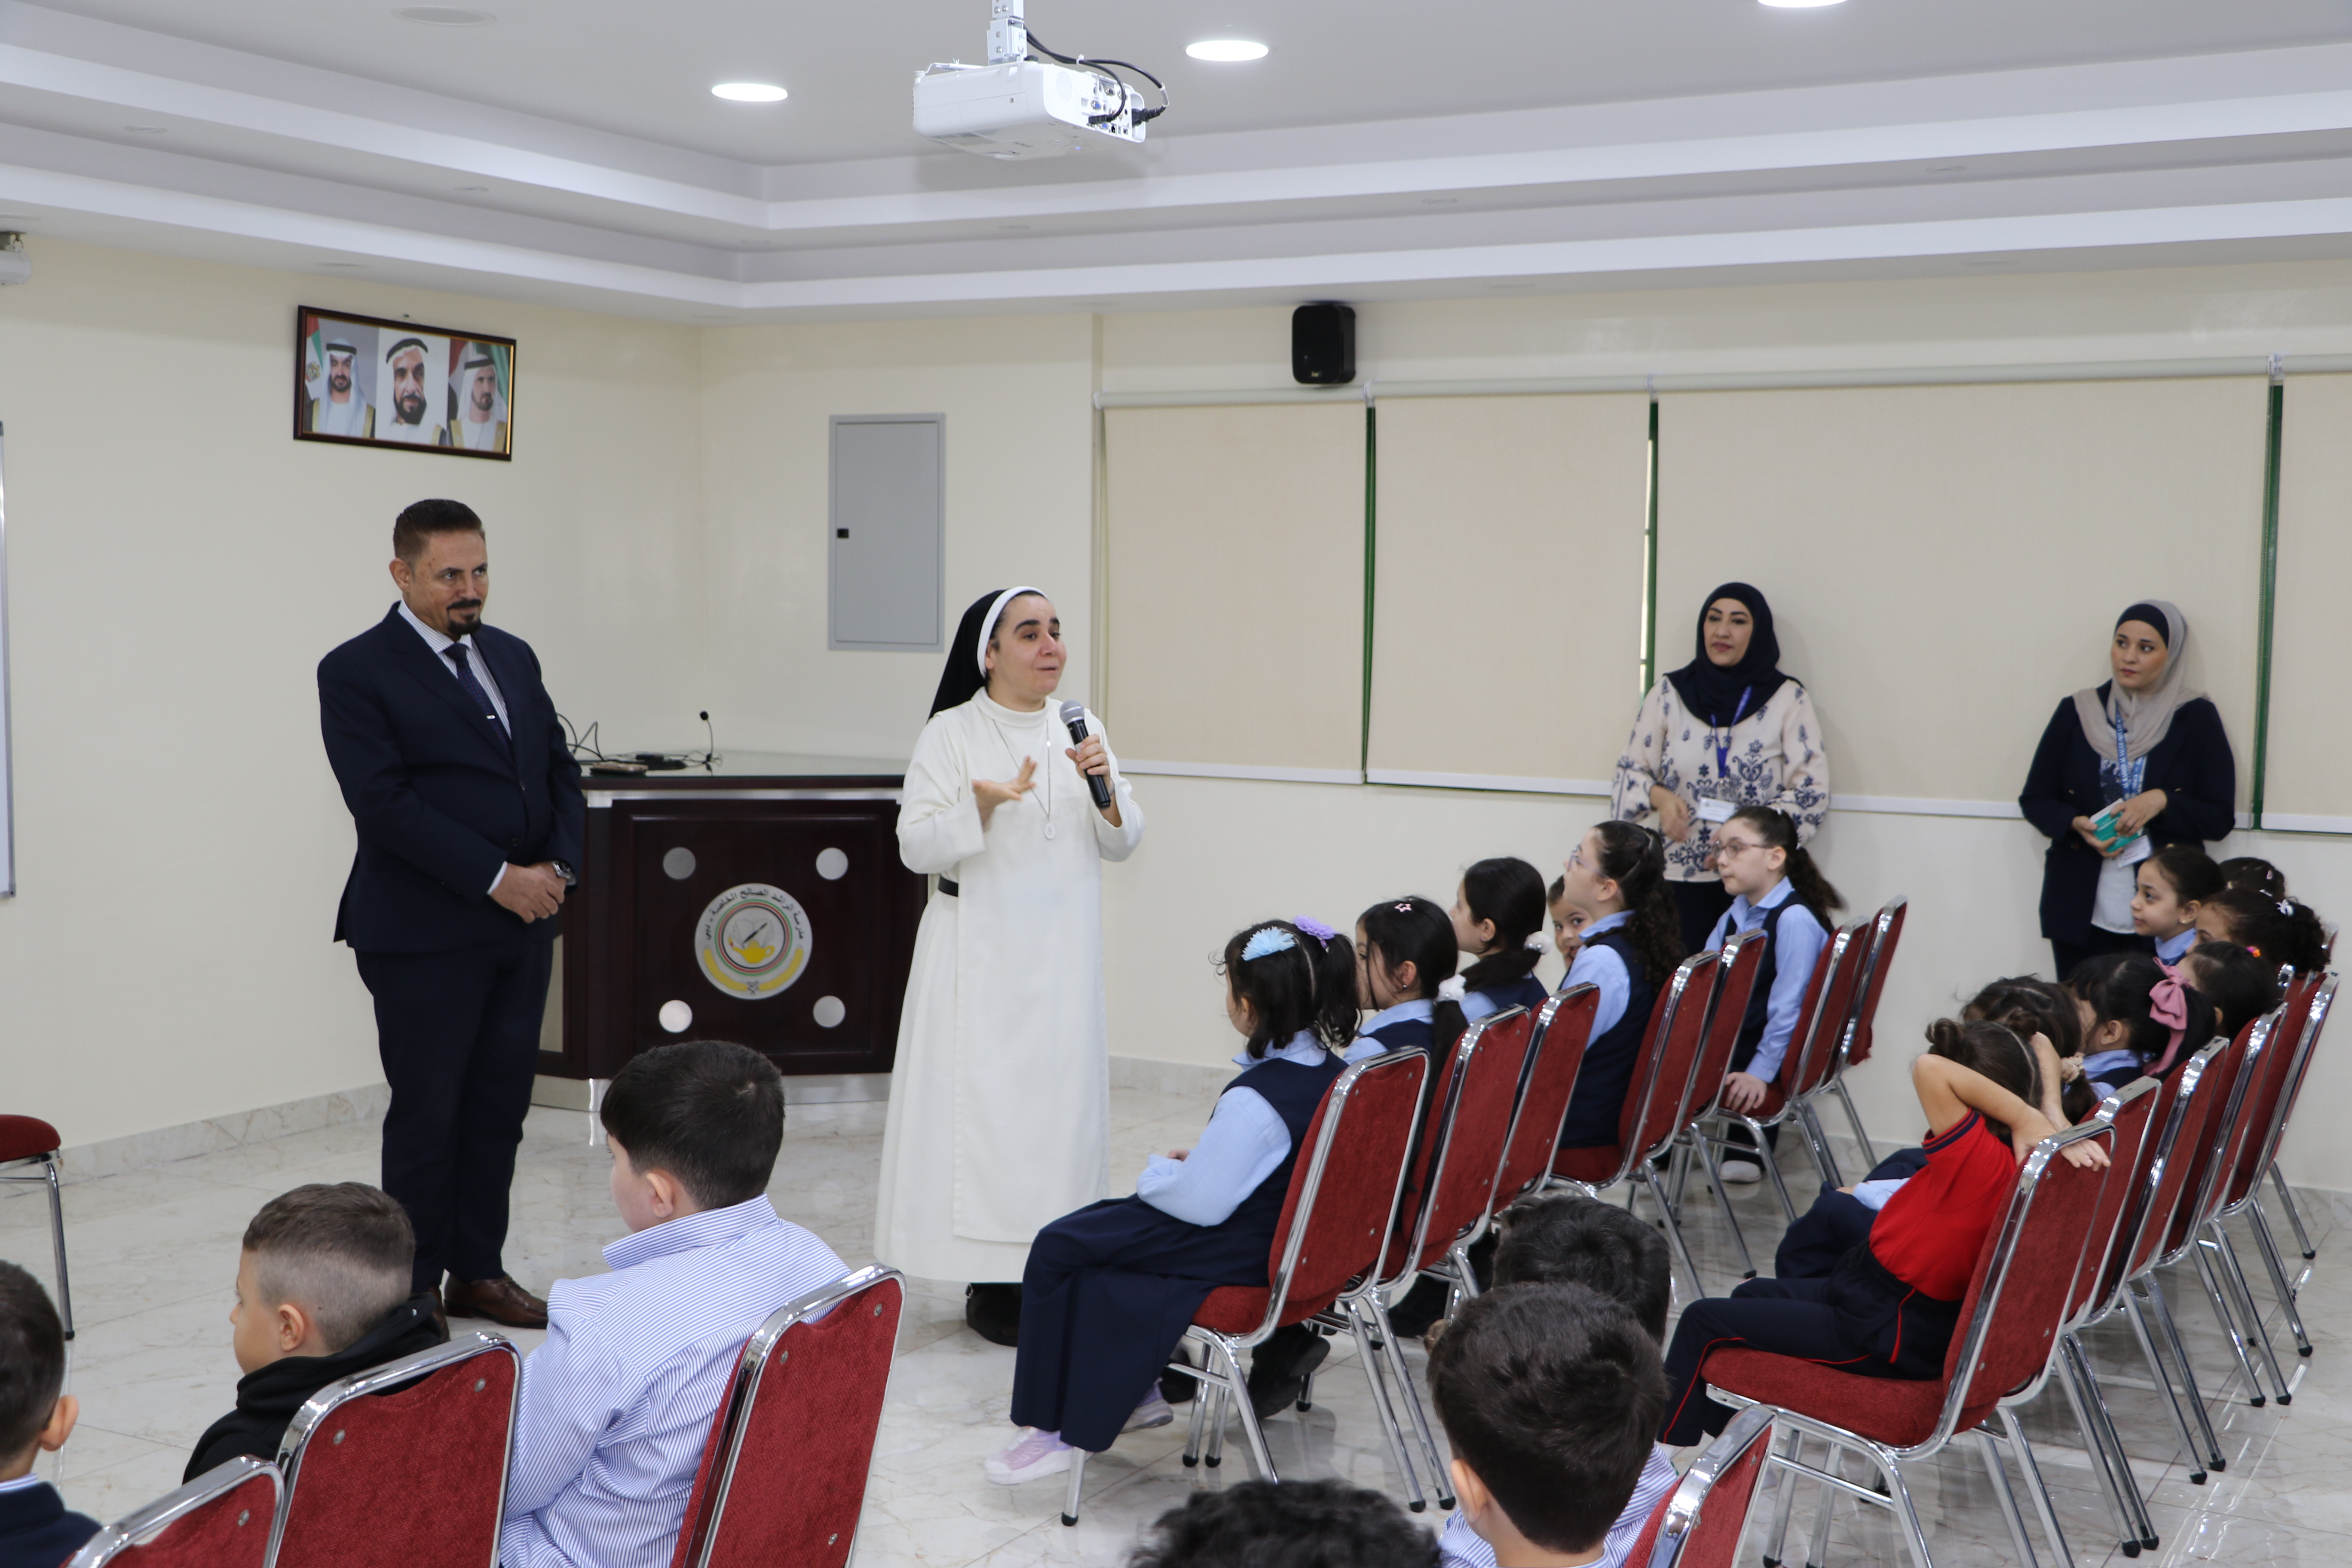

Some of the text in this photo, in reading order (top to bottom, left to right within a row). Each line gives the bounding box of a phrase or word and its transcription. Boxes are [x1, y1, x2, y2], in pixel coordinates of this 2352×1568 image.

[740, 886, 769, 899] الصالح
[771, 894, 794, 910] الراشد
[709, 892, 737, 915] الخاصة
[793, 910, 805, 939] مدرسة
